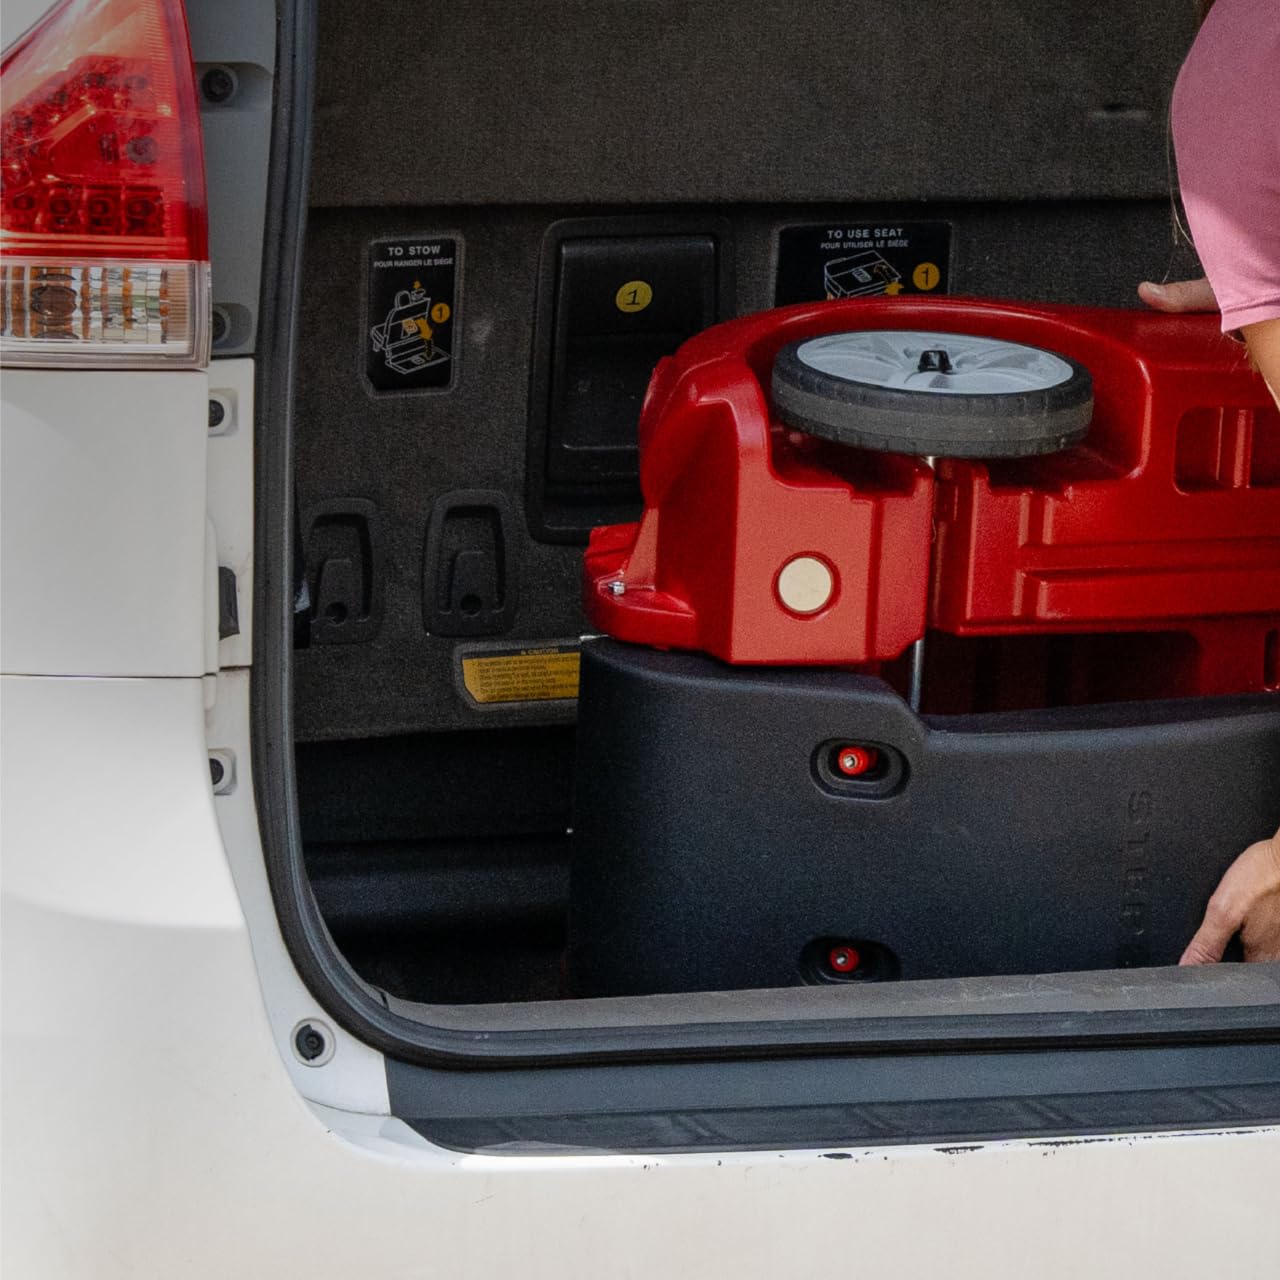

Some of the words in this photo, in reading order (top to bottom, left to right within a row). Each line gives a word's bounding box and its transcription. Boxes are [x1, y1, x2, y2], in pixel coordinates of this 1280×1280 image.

[827, 230, 843, 239] TO
[847, 229, 870, 238] USE
[874, 228, 903, 237] SEAT
[876, 239, 886, 248] LE
[388, 247, 404, 256] TO
[409, 246, 441, 255] STOW
[374, 260, 393, 268] POUR
[423, 257, 432, 266] LE
